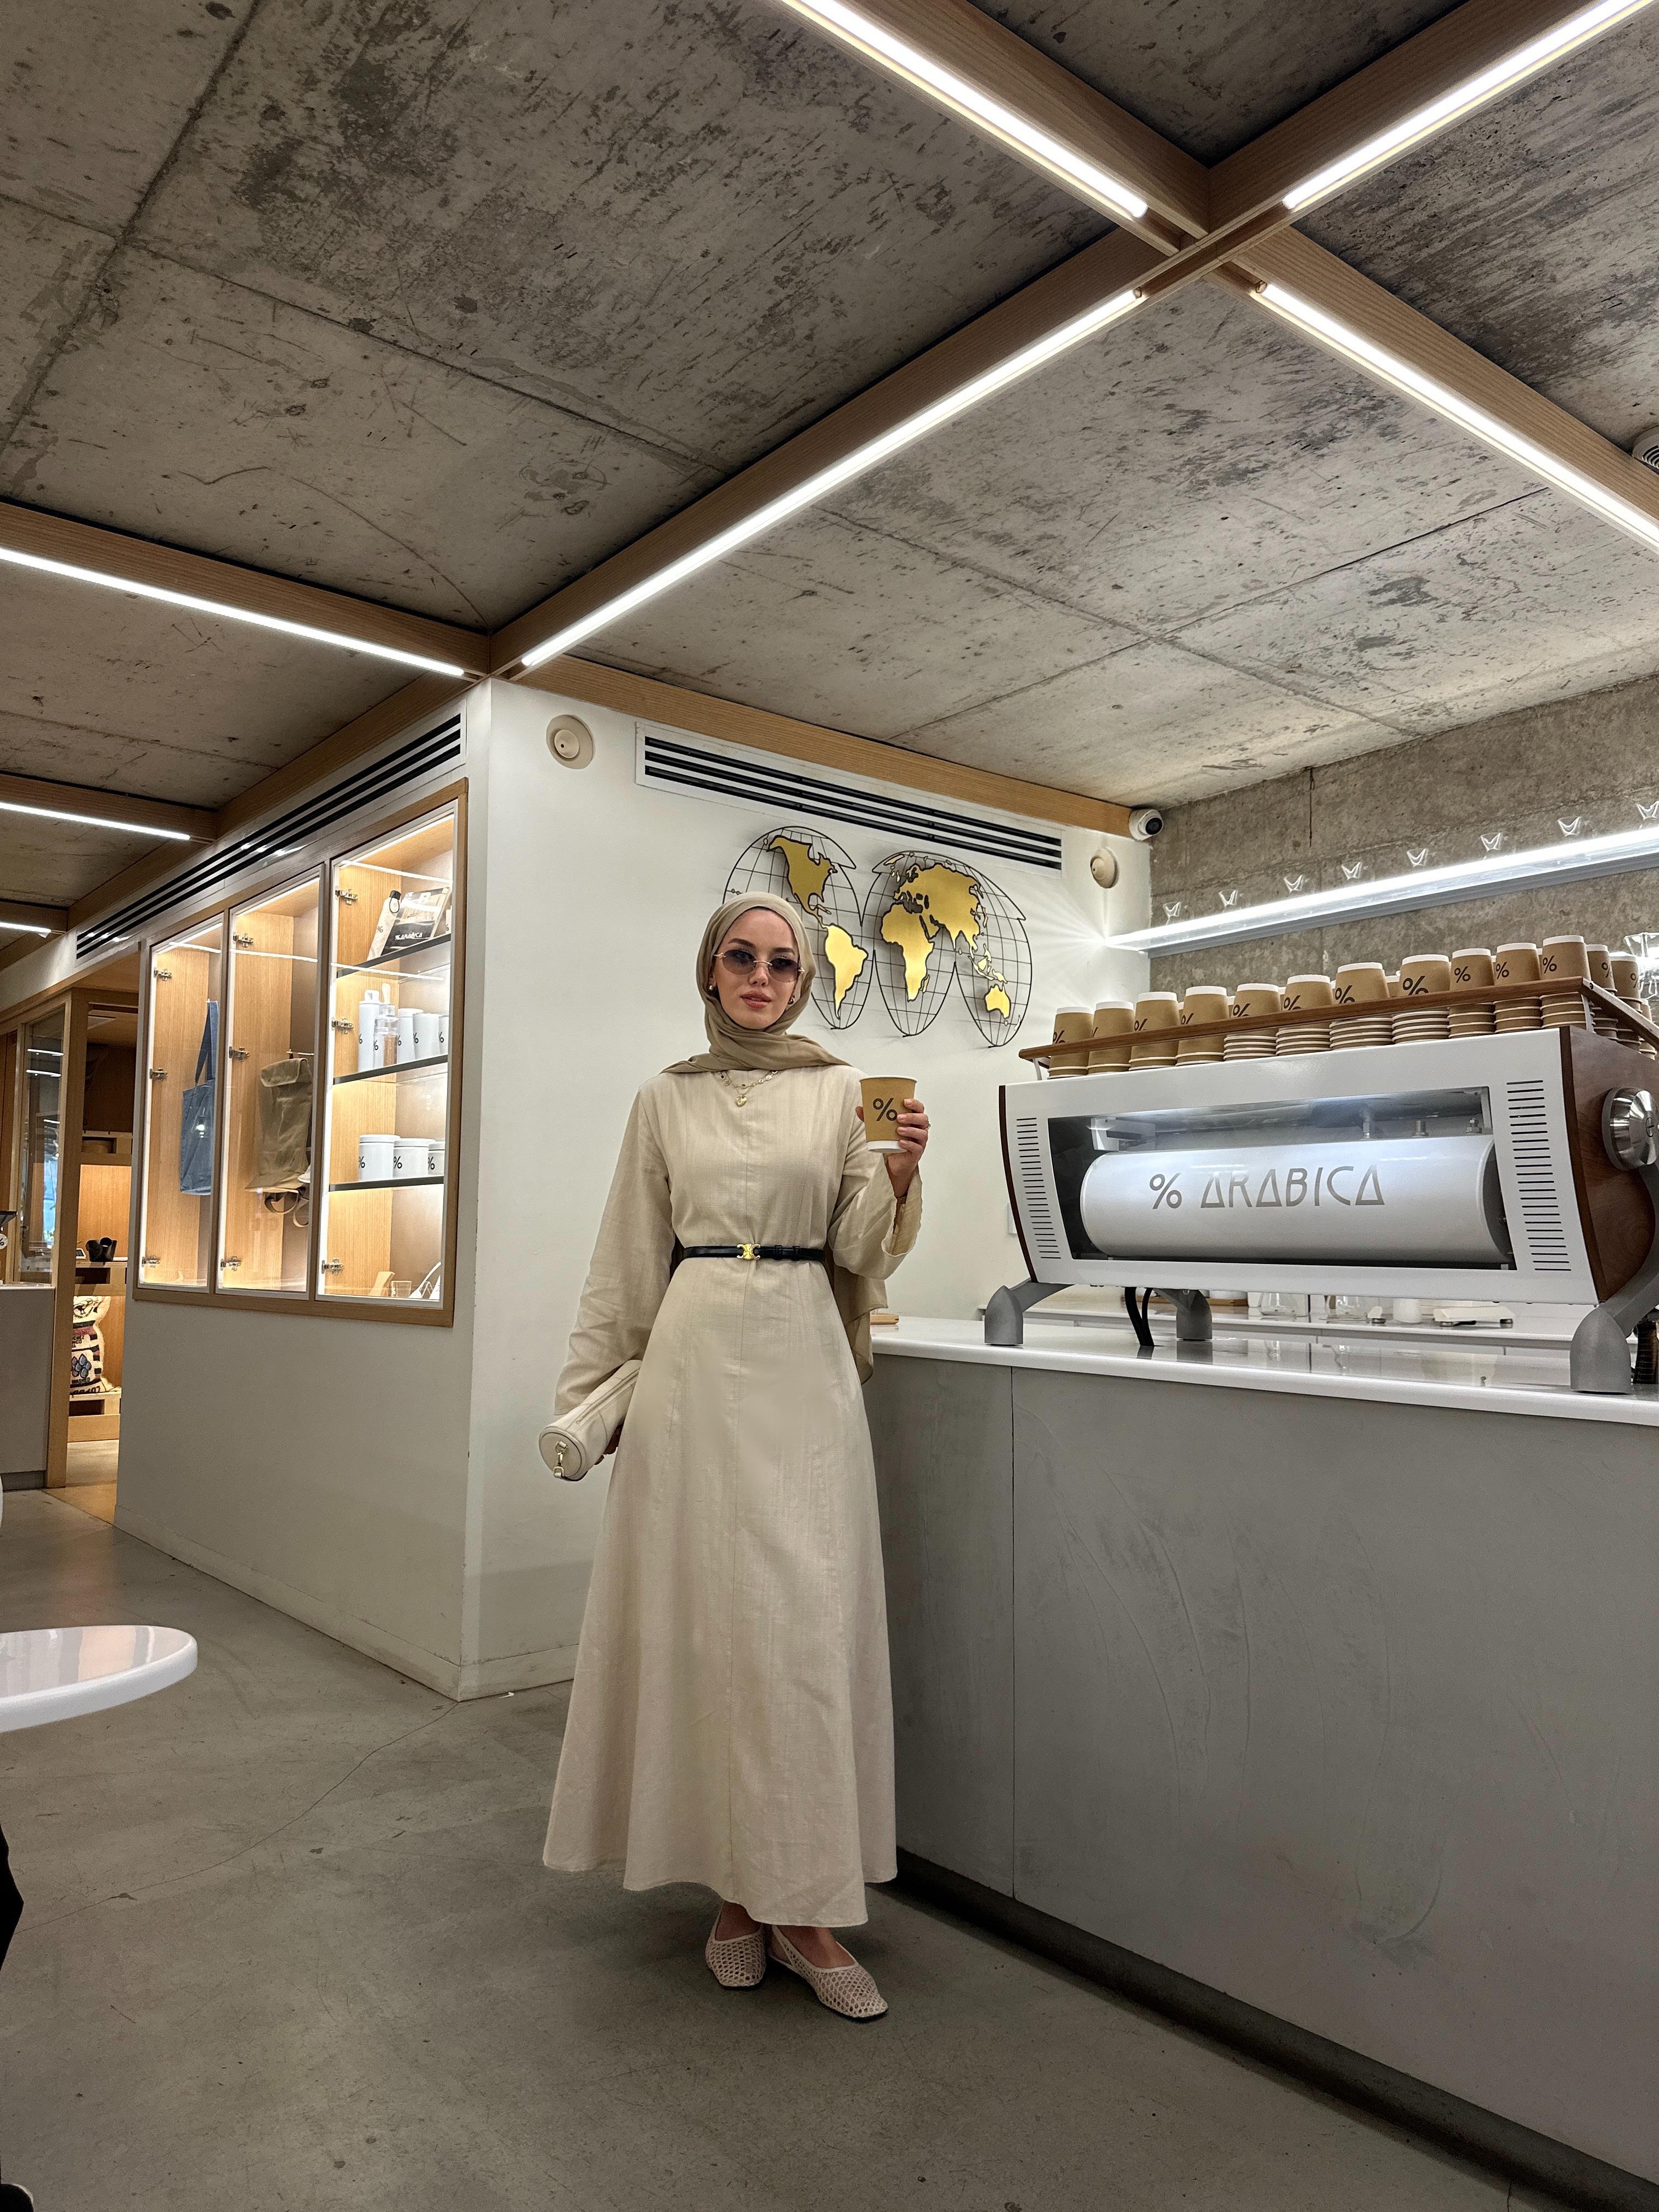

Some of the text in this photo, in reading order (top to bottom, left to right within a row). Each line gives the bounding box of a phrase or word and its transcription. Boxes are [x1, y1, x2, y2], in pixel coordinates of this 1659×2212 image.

[1496, 962, 1509, 979] %
[1542, 955, 1558, 974] %
[1454, 966, 1471, 983] %
[873, 1097, 898, 1121] %
[1149, 1165, 1385, 1209] % ARABICA
